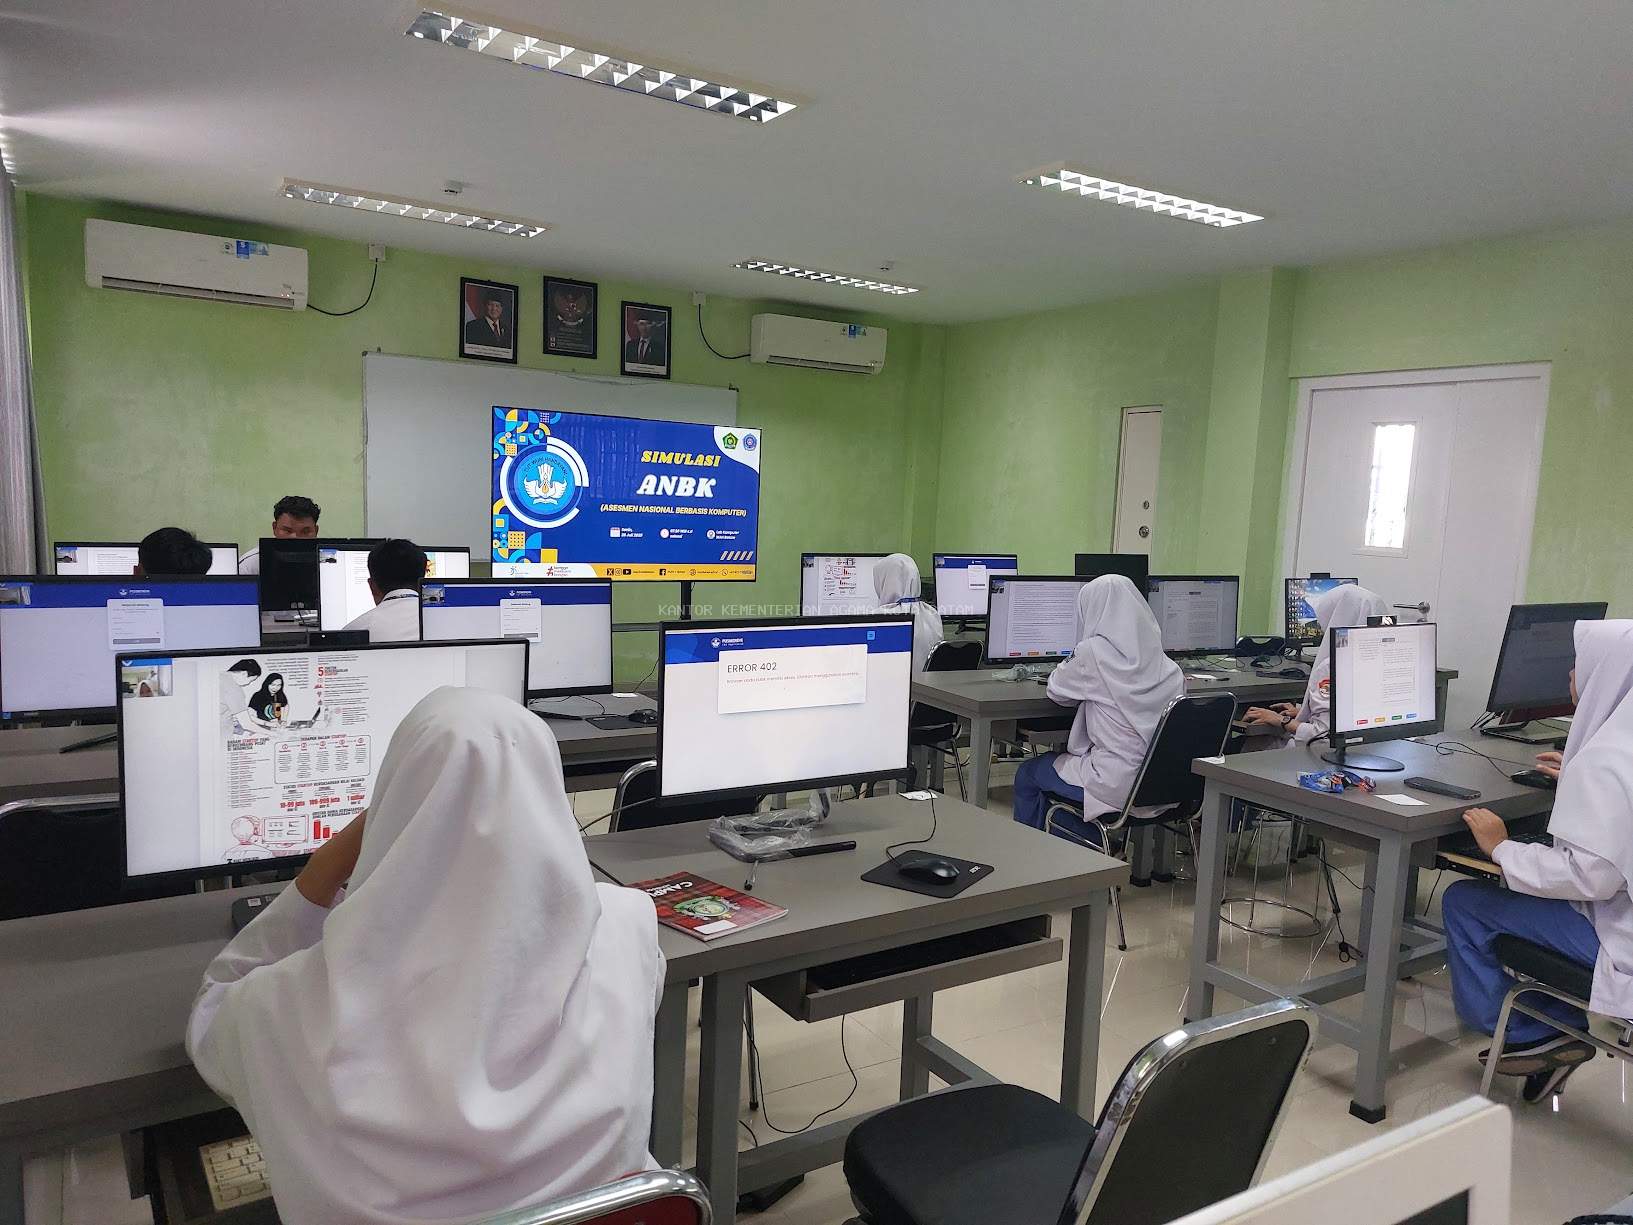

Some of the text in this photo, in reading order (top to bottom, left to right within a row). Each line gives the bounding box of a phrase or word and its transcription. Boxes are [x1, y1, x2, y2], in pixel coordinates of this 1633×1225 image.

[641, 450, 721, 467] SIMULASI
[636, 474, 717, 498] ANBK
[600, 504, 747, 518] (ASESMEN NASIONAL BERBASIS KOMPUTER)
[727, 662, 777, 673] ERROR 402
